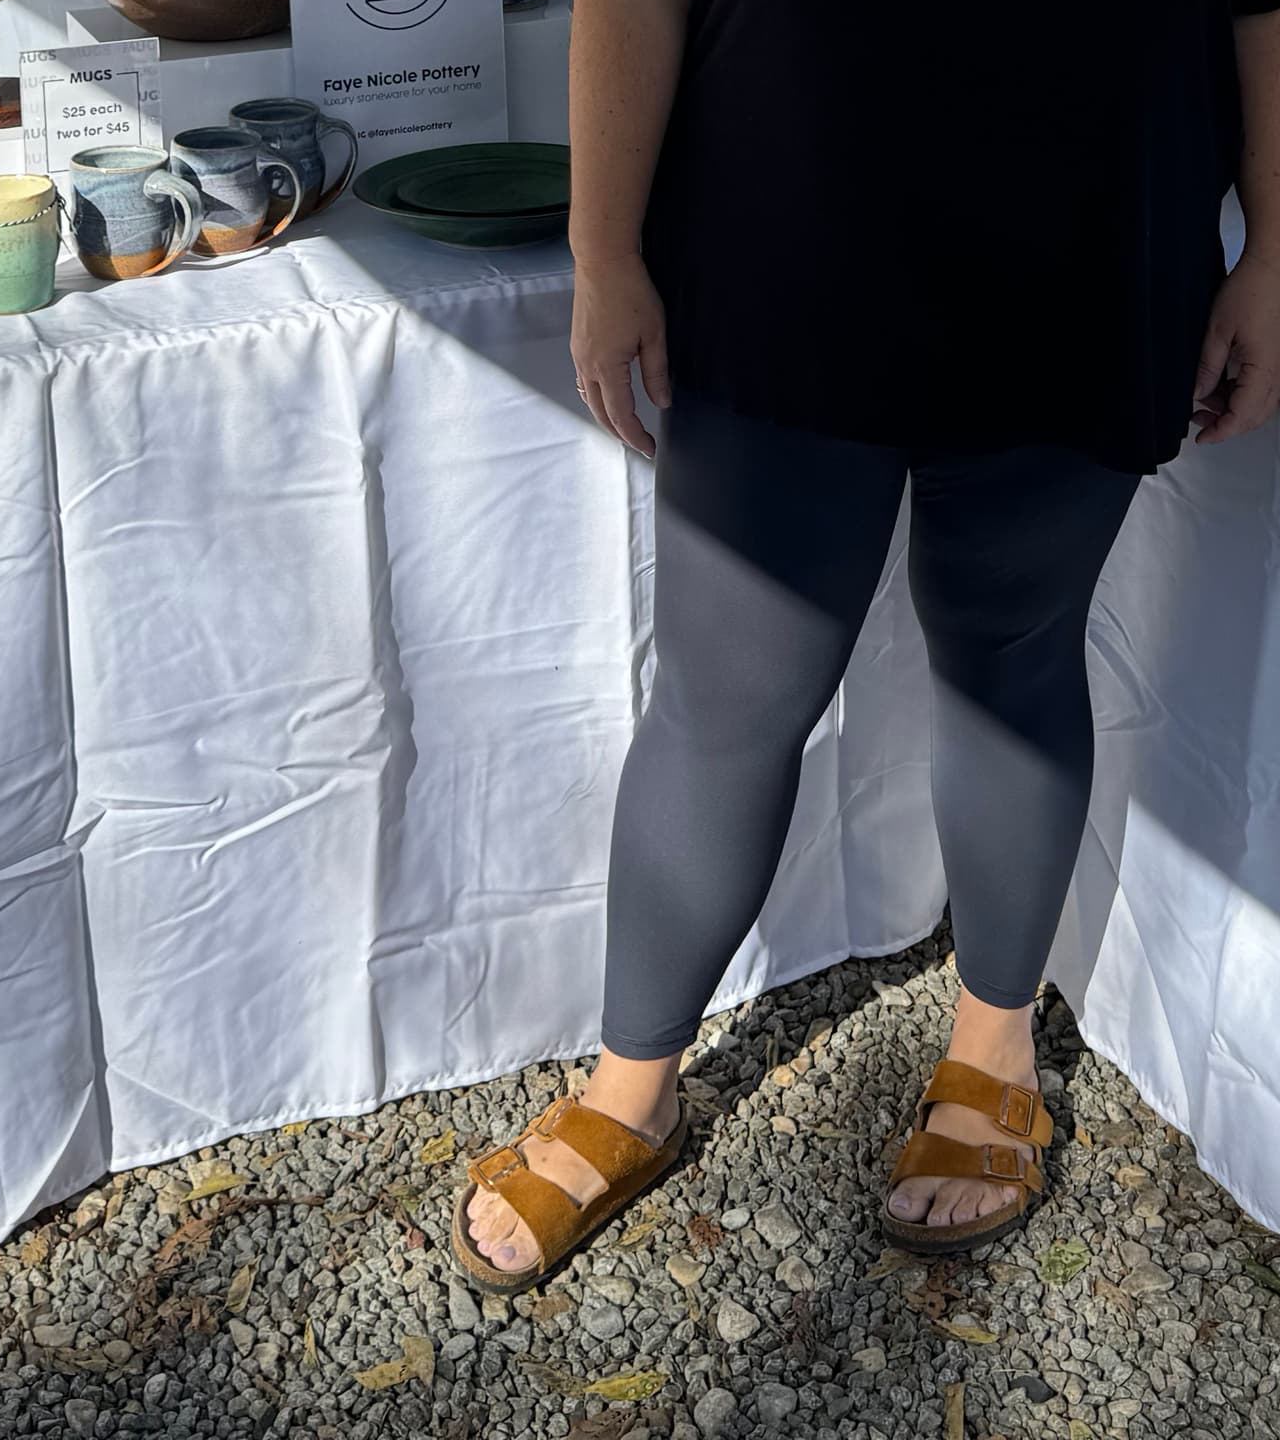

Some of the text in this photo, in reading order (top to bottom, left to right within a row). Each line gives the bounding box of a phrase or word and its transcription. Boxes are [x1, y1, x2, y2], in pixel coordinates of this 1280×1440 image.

[70, 69, 113, 84] MUGS
[323, 64, 481, 93] Faye Nicole Pottery
[323, 80, 483, 107] luxury stoneware for your home
[62, 103, 122, 119] $25 each
[57, 122, 130, 140] two for $45
[368, 121, 453, 138] @fayenicolepottery
